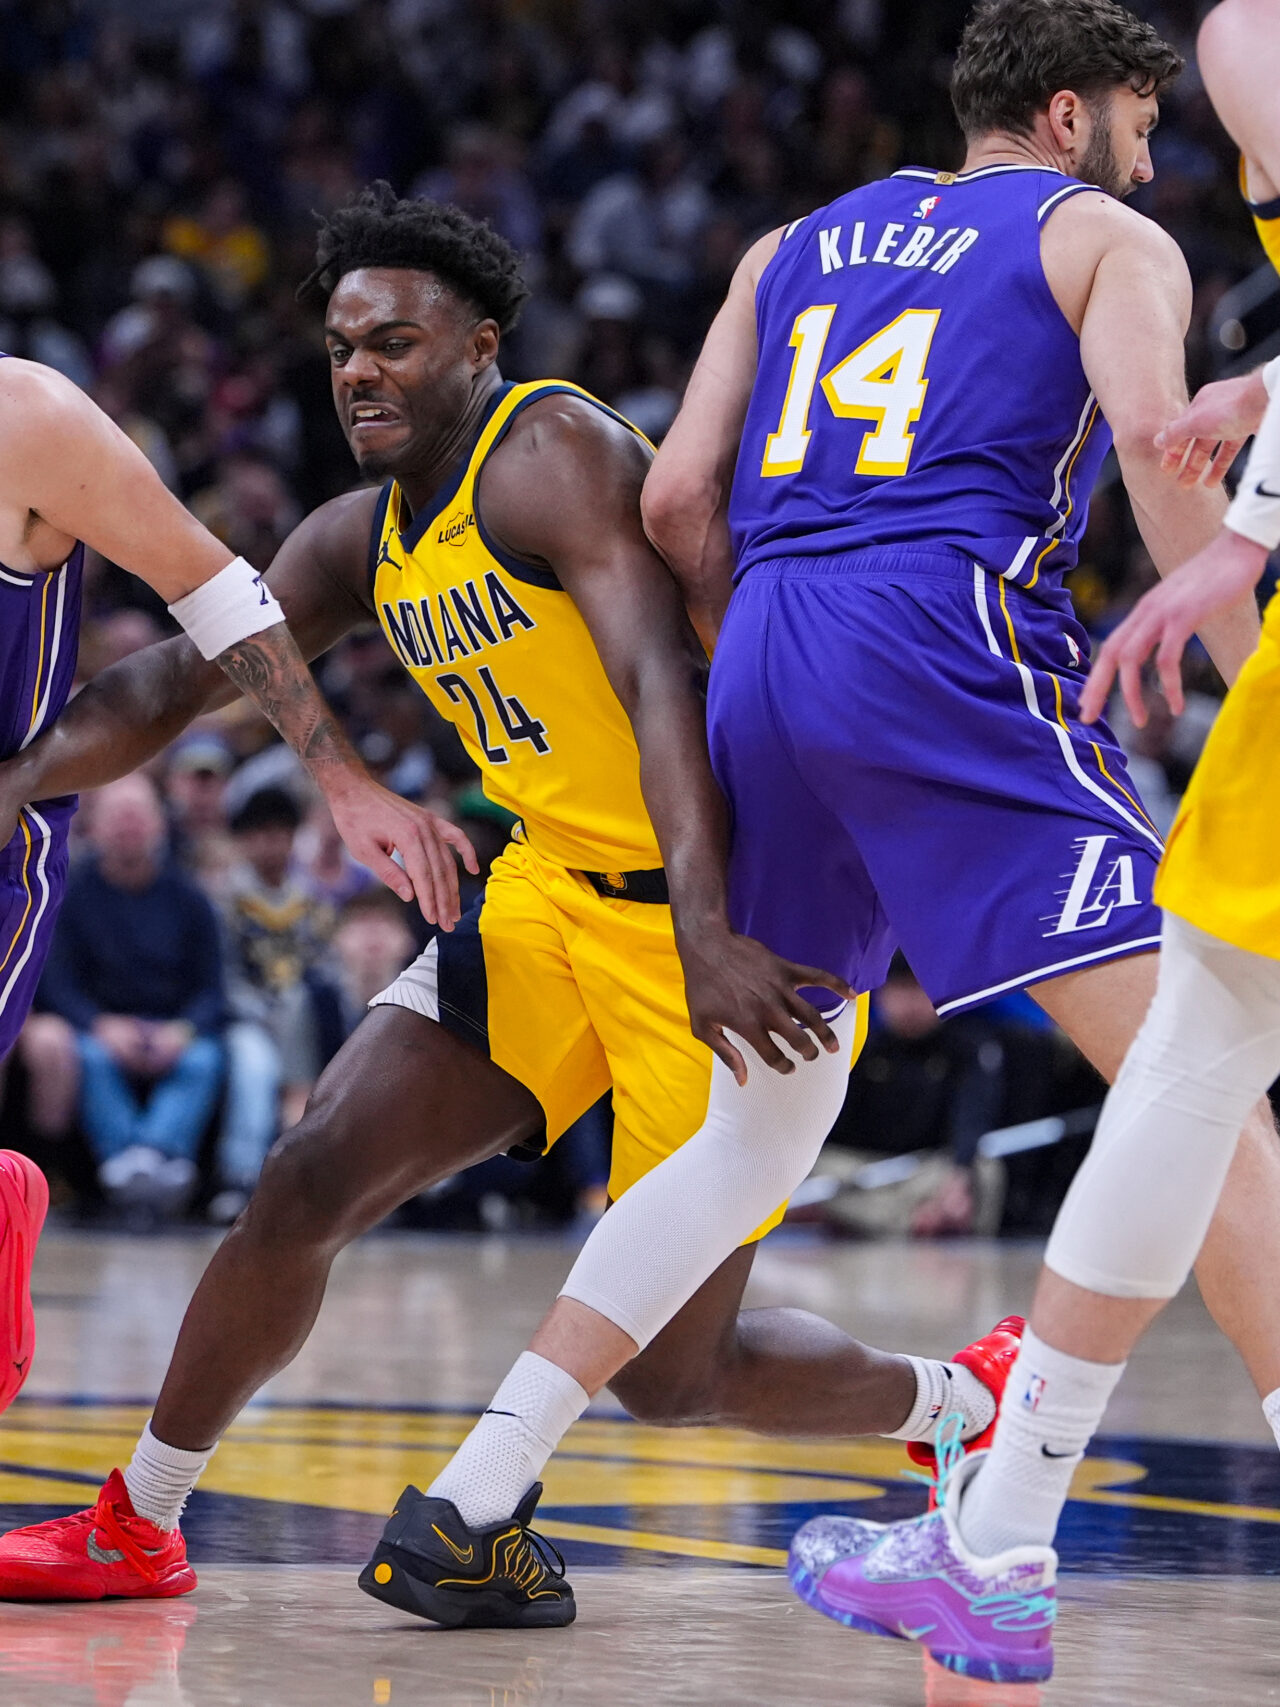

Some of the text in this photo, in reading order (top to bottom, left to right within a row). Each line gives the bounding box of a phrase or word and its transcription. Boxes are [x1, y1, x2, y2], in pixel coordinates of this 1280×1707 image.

[819, 221, 979, 275] KLEBER
[760, 304, 942, 478] 14
[381, 570, 537, 668] NDIANA
[435, 664, 552, 765] 24
[1039, 835, 1143, 938] LA
